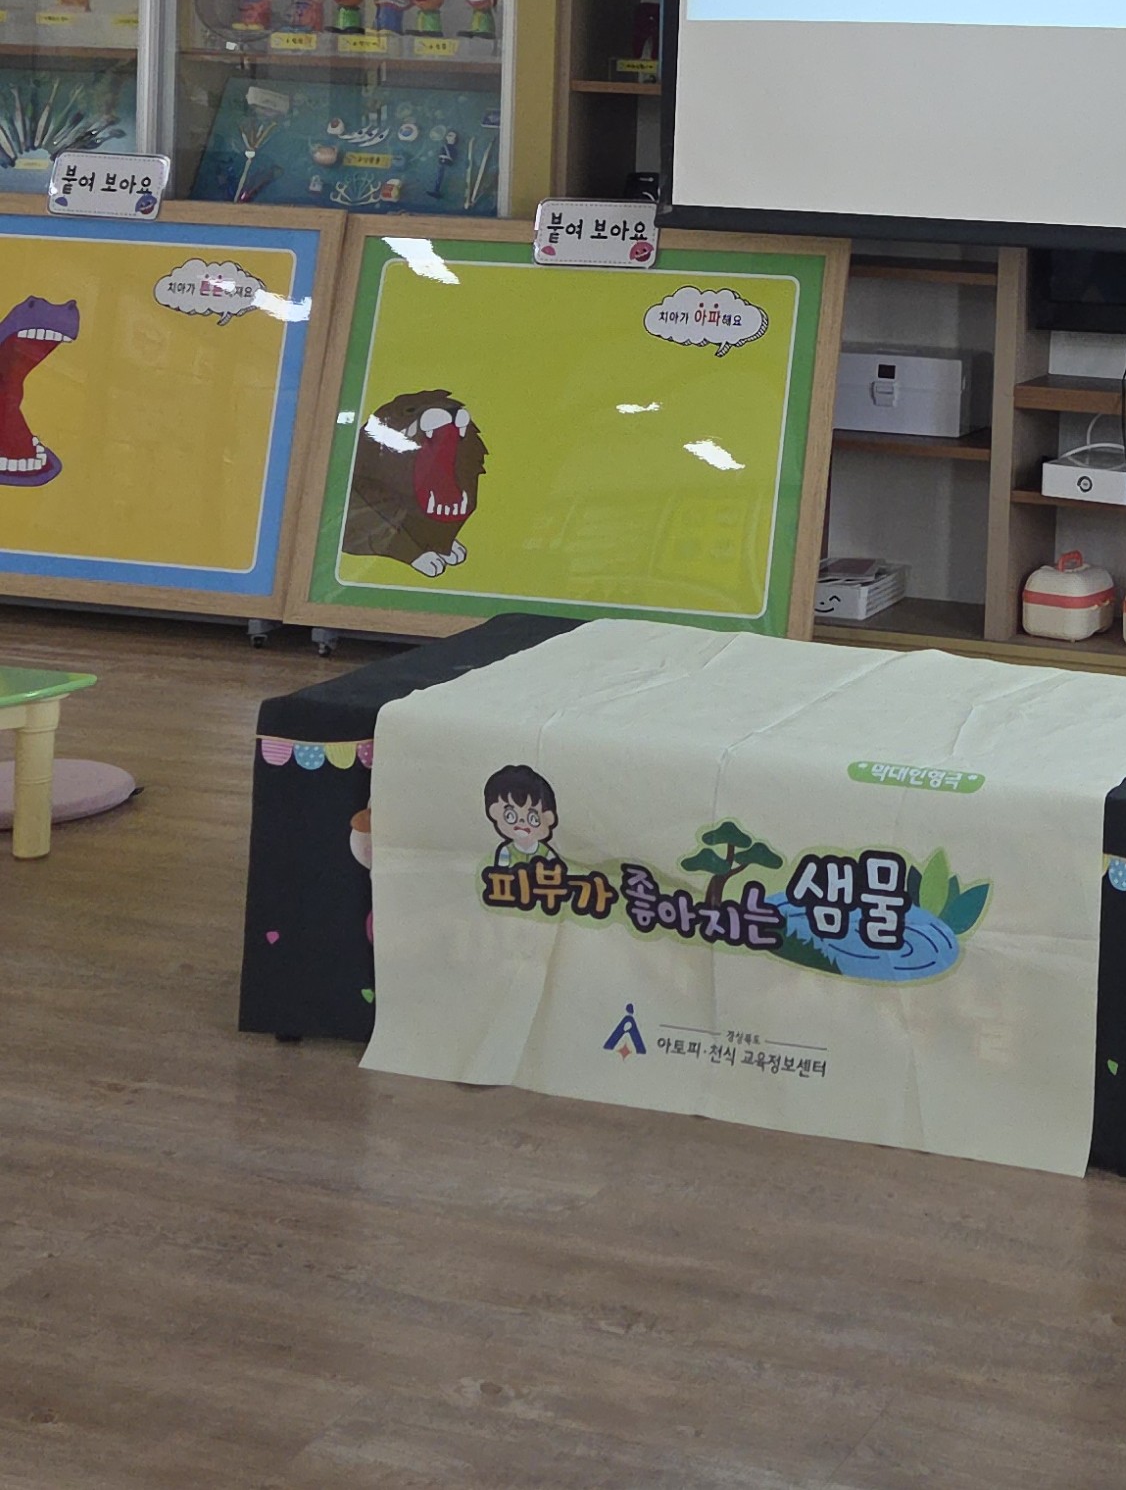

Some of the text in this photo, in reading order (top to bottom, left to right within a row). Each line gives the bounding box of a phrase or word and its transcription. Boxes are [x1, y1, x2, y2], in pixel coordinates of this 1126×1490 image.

[61, 165, 153, 195] 붙여 보아요
[547, 212, 648, 244] 붙여 보아요
[168, 282, 196, 296] 치아가
[659, 309, 742, 326] 치아가 아파해요
[871, 764, 963, 789] 막대인형극
[487, 855, 906, 946] 피부가 좋아지는 샘물
[740, 1050, 827, 1078] 교육정보센터
